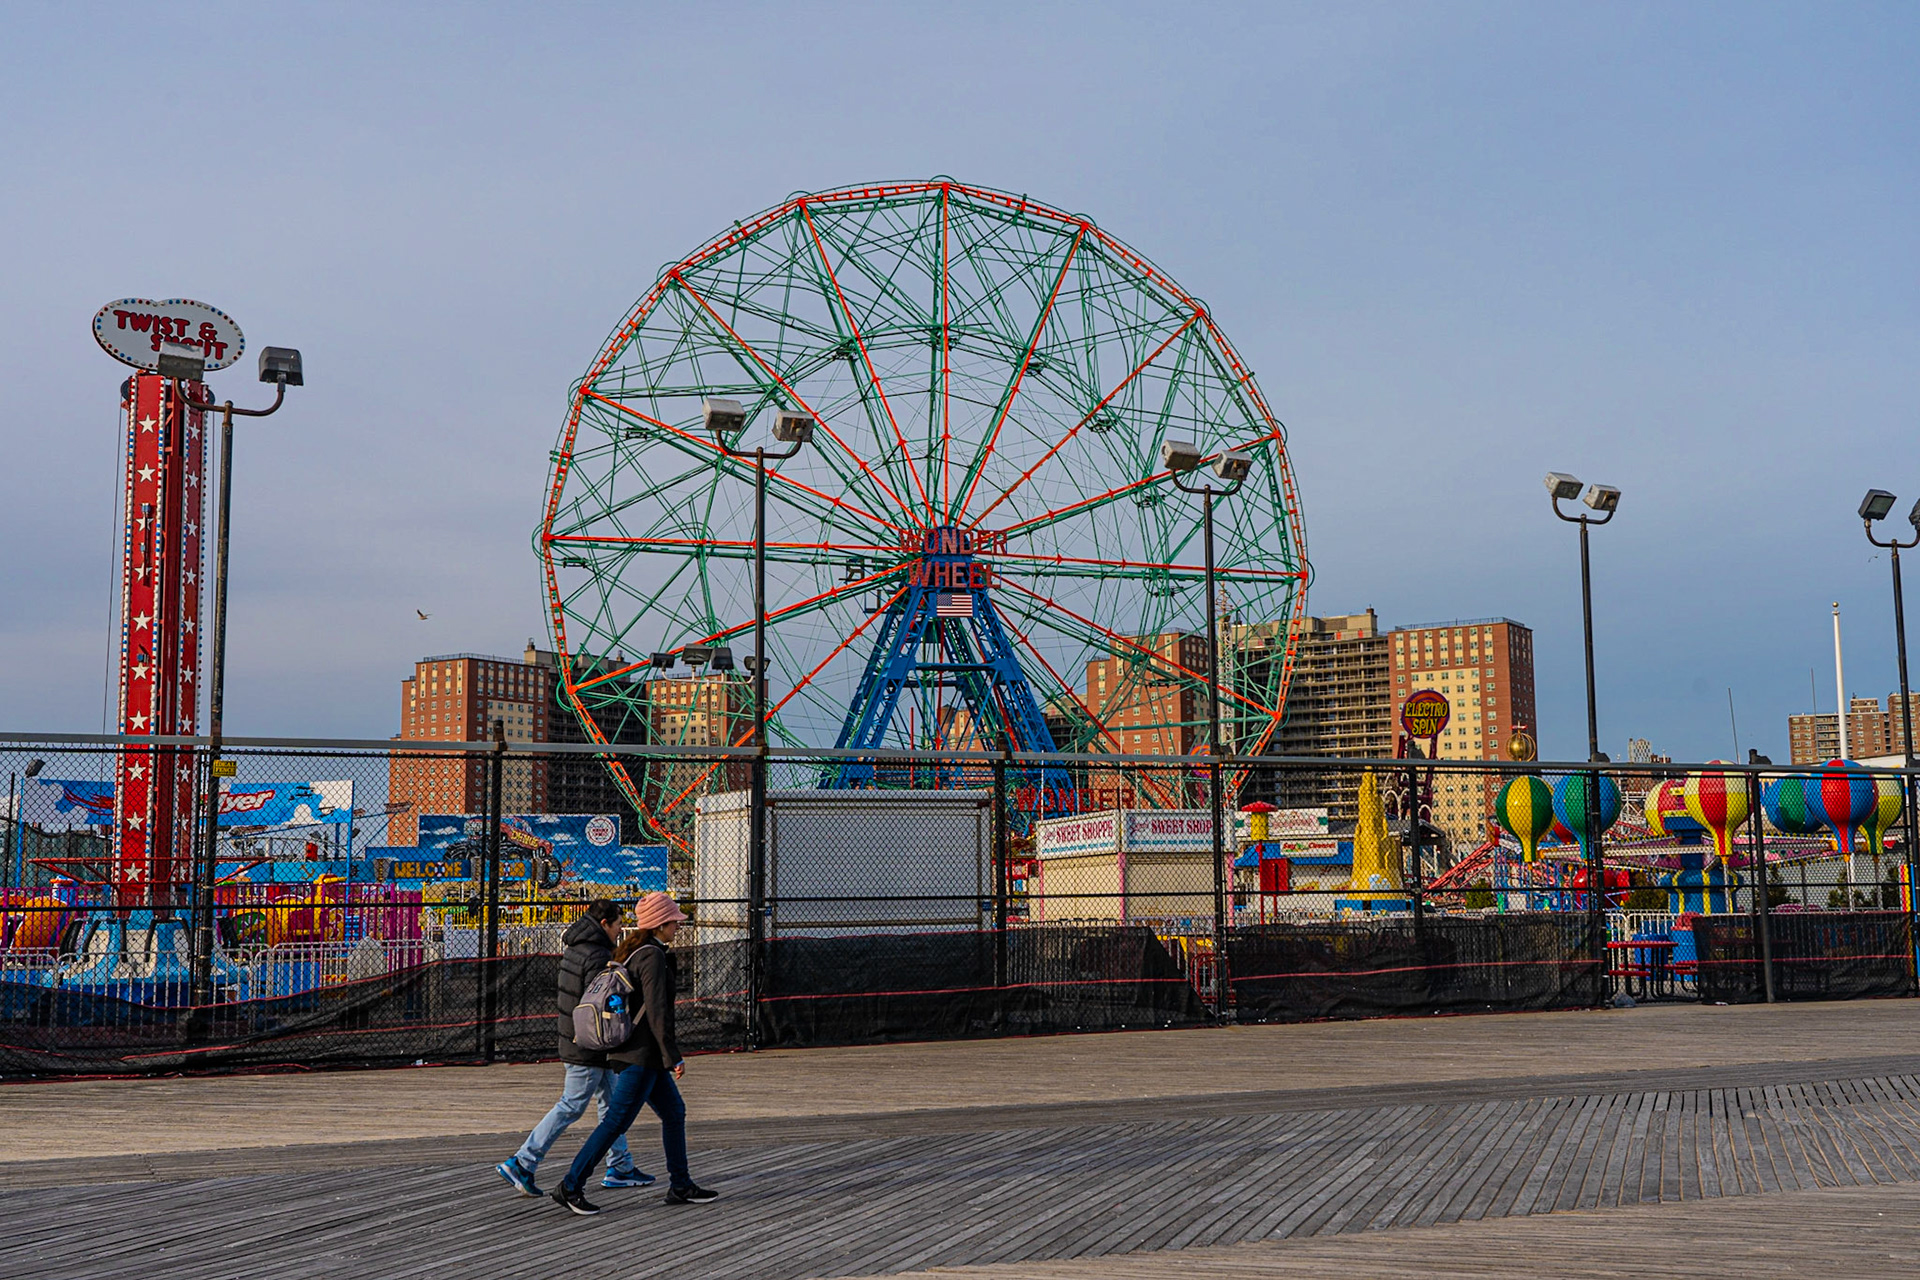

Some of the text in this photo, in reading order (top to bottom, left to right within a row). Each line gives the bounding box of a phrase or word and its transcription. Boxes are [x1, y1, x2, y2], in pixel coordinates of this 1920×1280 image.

[113, 310, 217, 342] TWIST &
[898, 528, 1008, 555] WONDER
[908, 561, 1002, 588] WHEEL
[1405, 702, 1448, 717] ELECTRO
[1412, 718, 1438, 735] SPIN
[209, 789, 275, 814] lyer
[1015, 787, 1136, 812] WONDER
[1056, 824, 1081, 843] SWEET
[1082, 820, 1115, 840] SHOPPE
[1151, 819, 1185, 835] SWEET
[1186, 819, 1222, 835] SHOP
[394, 862, 462, 878] WELCOME
